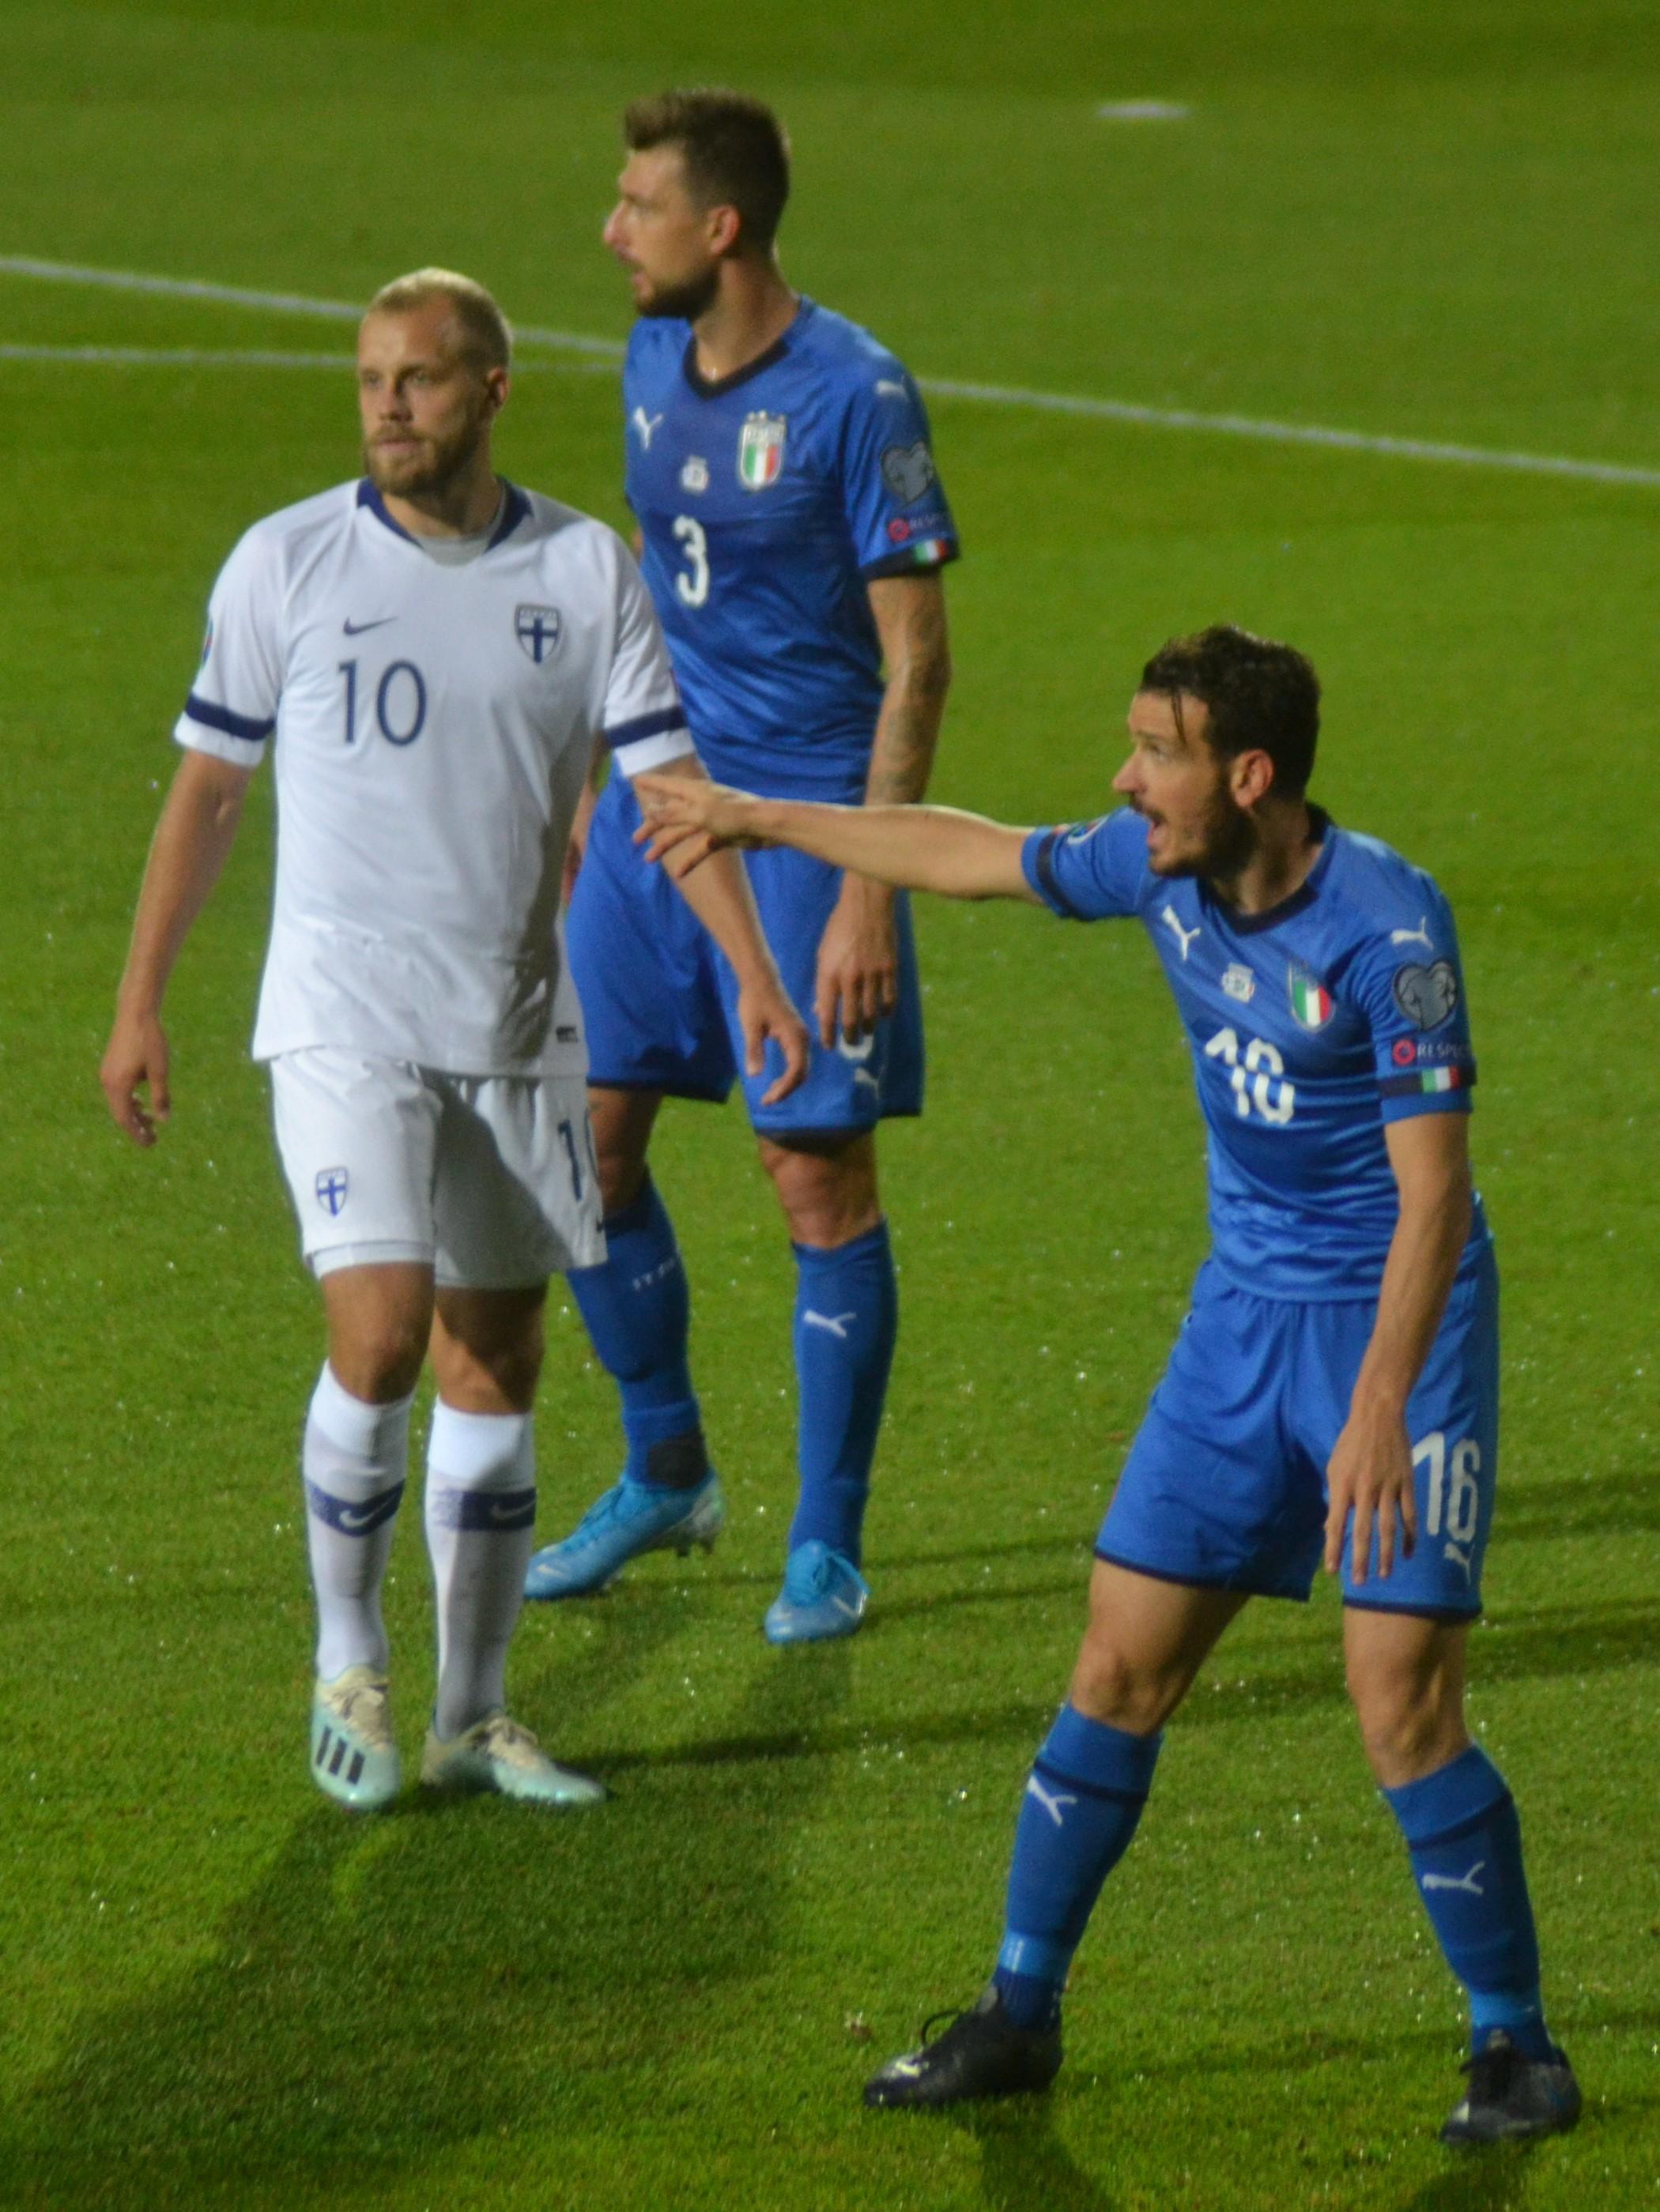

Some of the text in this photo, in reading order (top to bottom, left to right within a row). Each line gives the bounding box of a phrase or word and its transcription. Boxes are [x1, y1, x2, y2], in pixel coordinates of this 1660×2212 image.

[674, 514, 709, 607] 3
[338, 658, 427, 747] 10
[1412, 1432, 1481, 1543] 16
